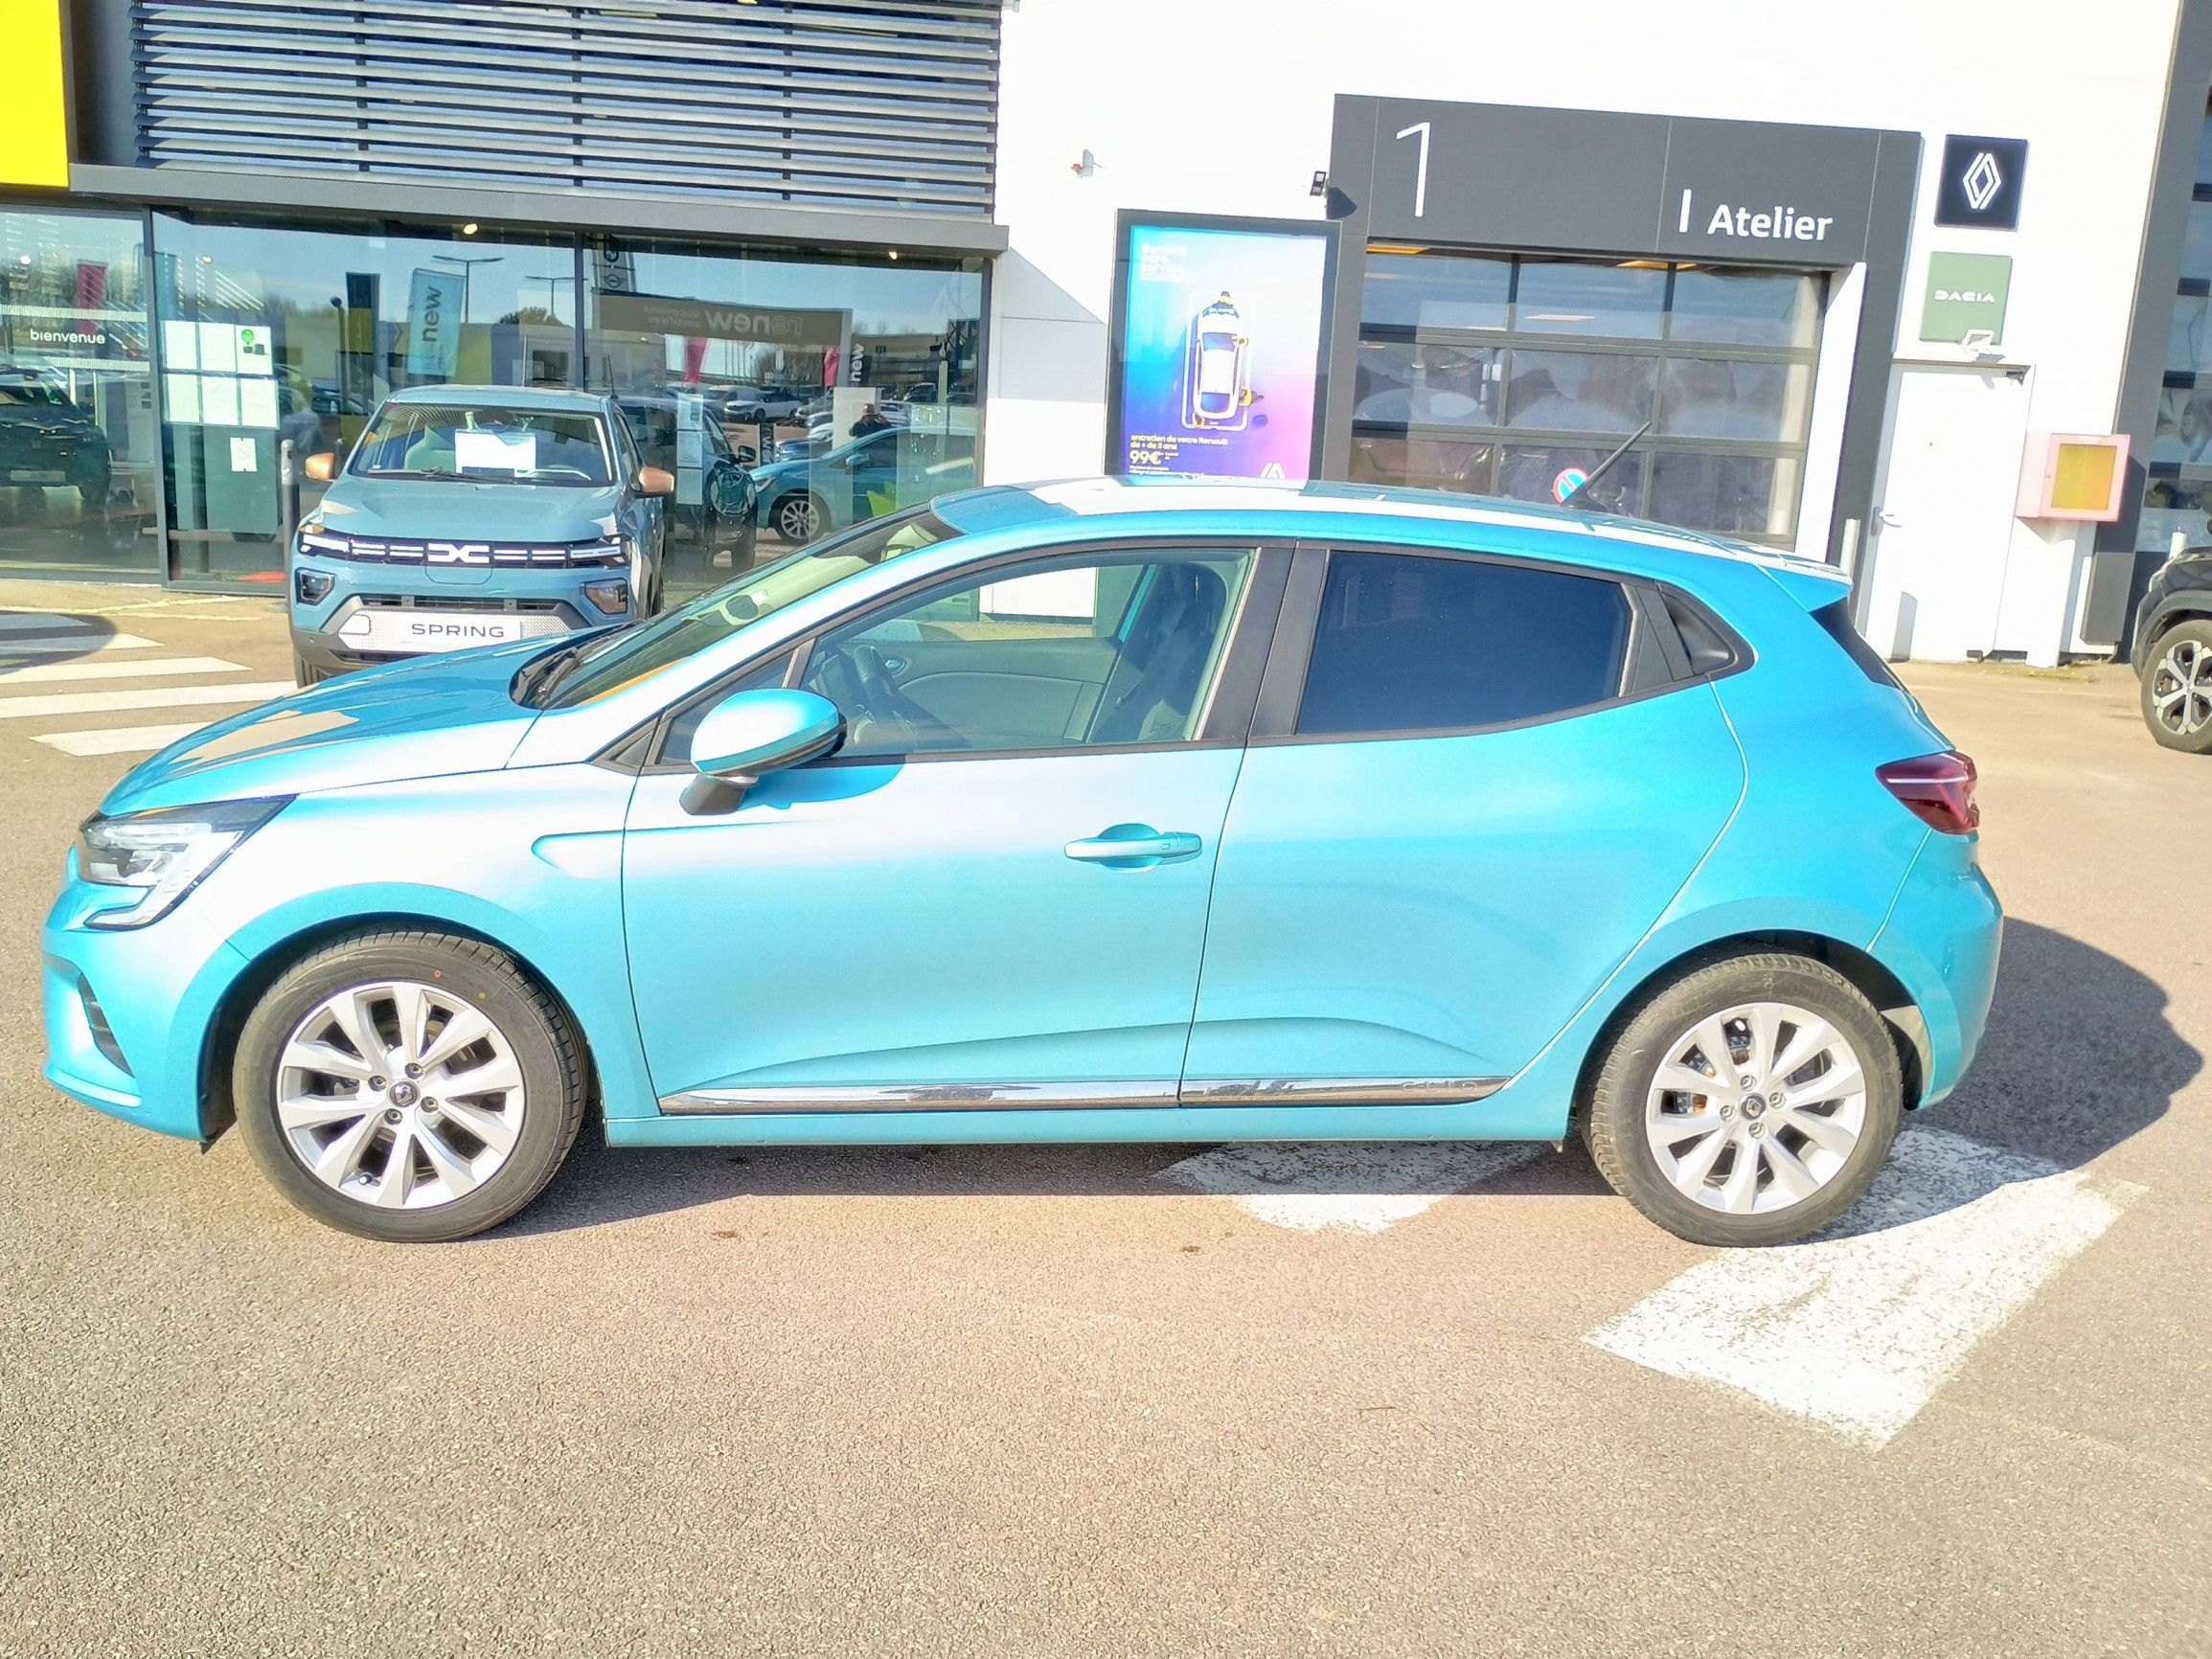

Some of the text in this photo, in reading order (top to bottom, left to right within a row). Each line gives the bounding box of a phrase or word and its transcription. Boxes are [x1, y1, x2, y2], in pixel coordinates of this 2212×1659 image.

[1396, 122, 1430, 217] 1
[1706, 204, 1834, 241] Atelier
[1933, 288, 1995, 304] DACIA
[30, 329, 106, 345] bienvenue
[411, 624, 505, 638] SPRING
